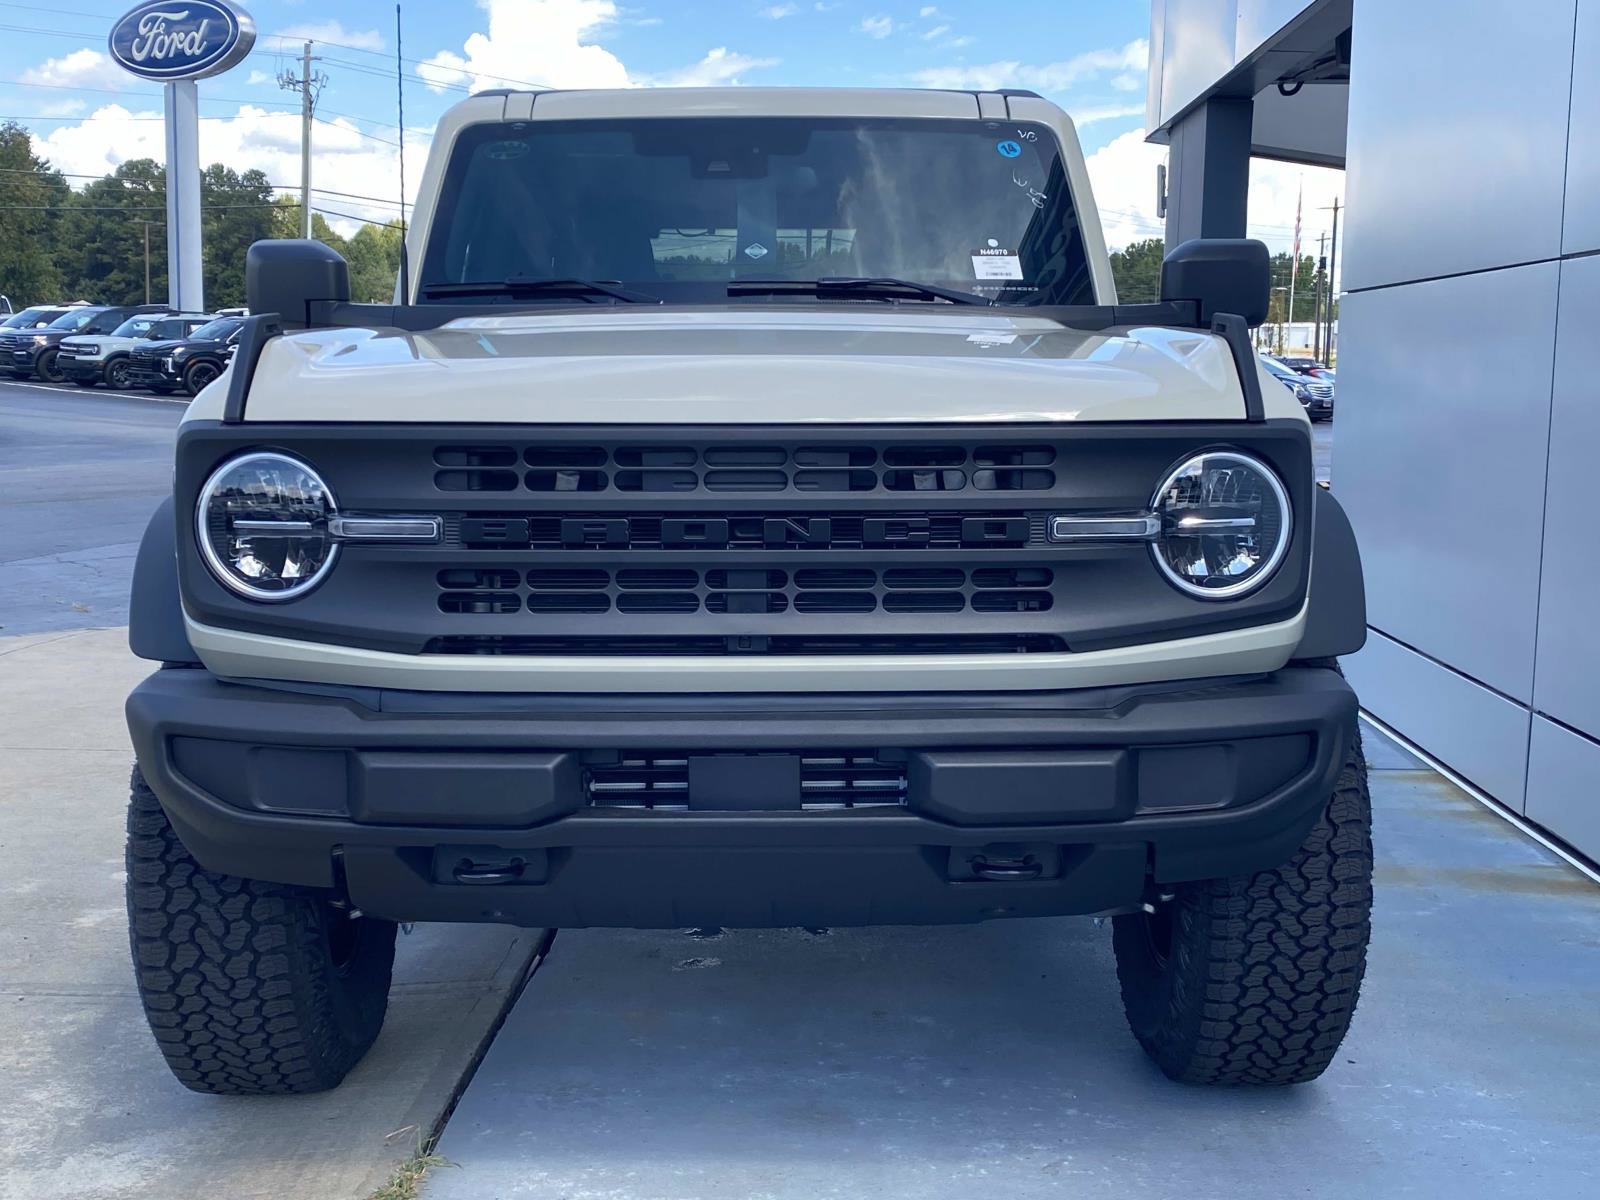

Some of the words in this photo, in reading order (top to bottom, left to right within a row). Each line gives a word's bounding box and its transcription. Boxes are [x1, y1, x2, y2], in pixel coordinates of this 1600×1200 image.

[131, 10, 209, 62] Ford
[1001, 143, 1018, 155] 14
[460, 518, 1029, 544] BRONCO
